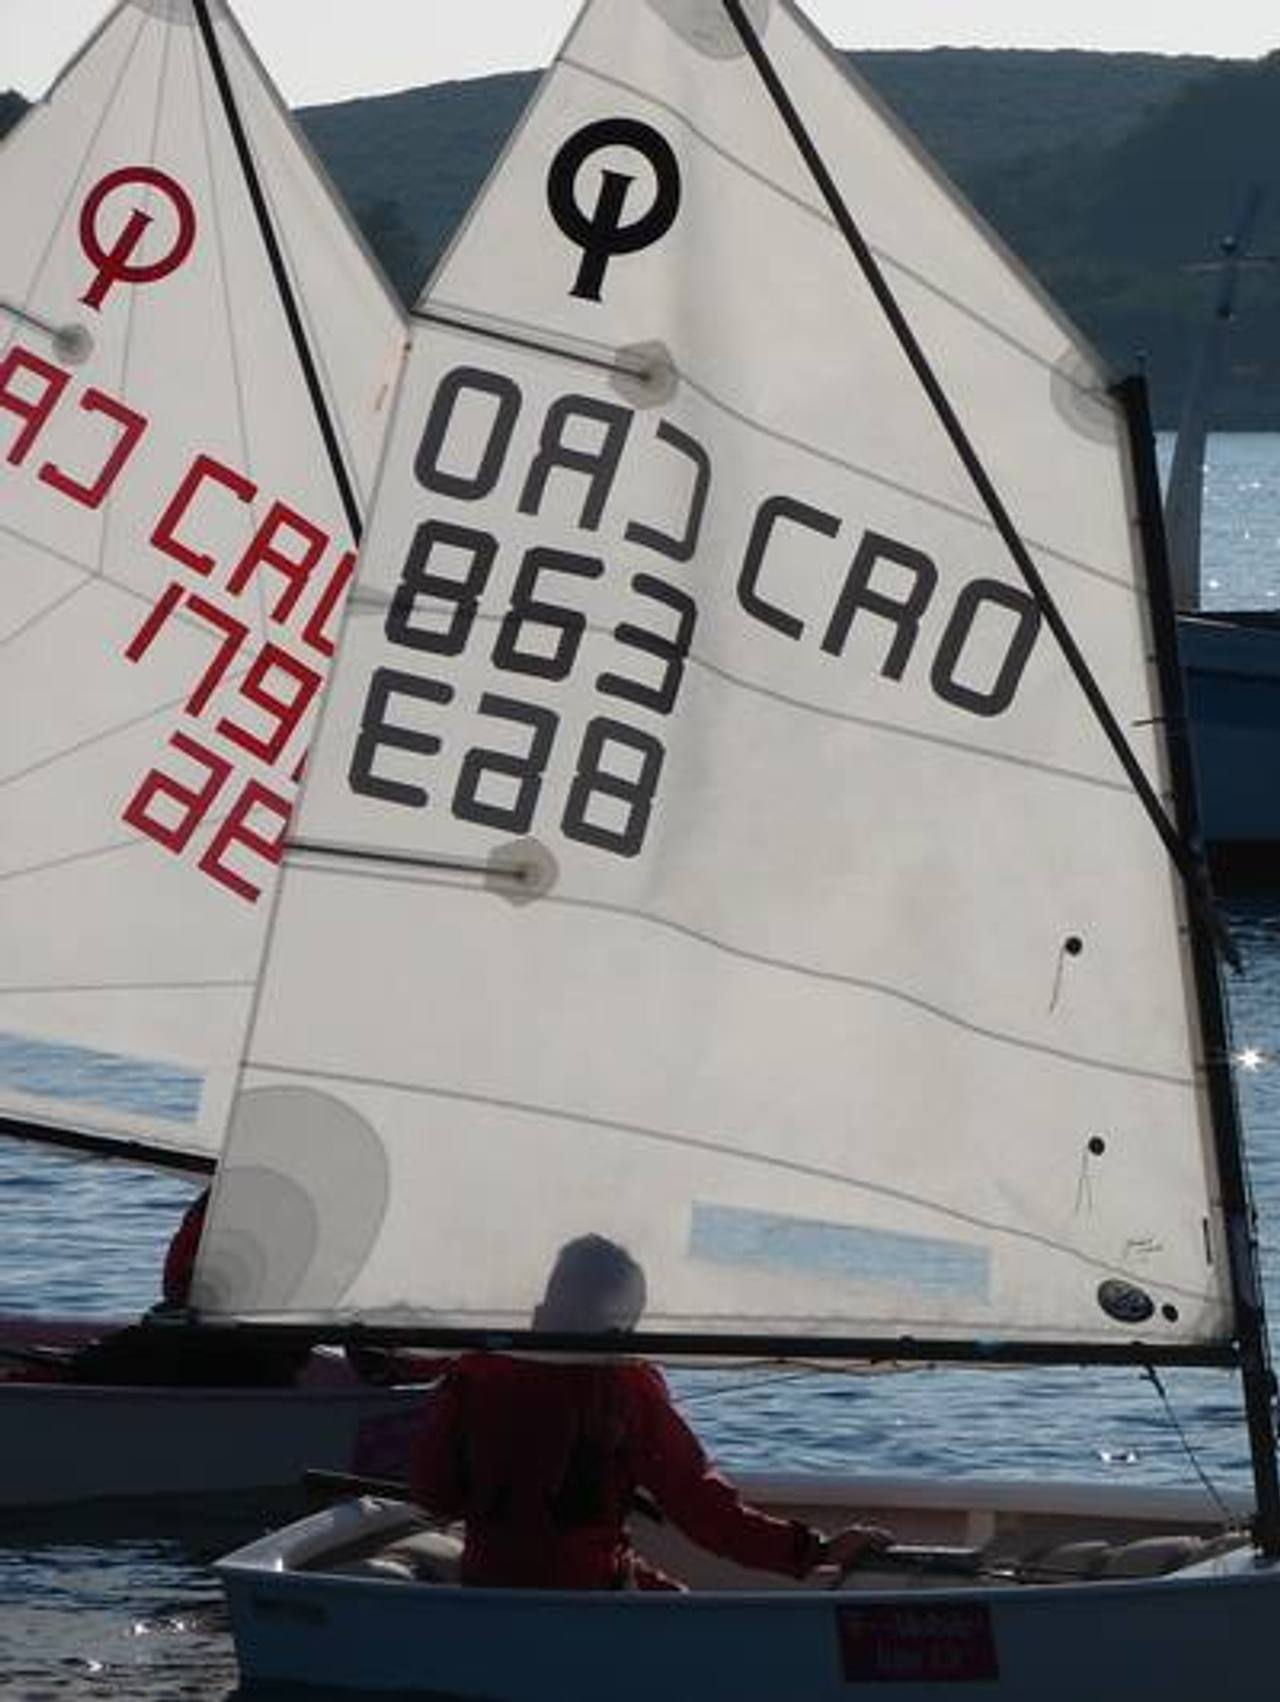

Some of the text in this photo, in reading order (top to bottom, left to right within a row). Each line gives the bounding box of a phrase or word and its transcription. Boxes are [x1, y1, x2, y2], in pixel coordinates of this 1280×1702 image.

[124, 581, 323, 784] 179
[384, 518, 698, 715] 863
[736, 495, 1042, 717] CRO
